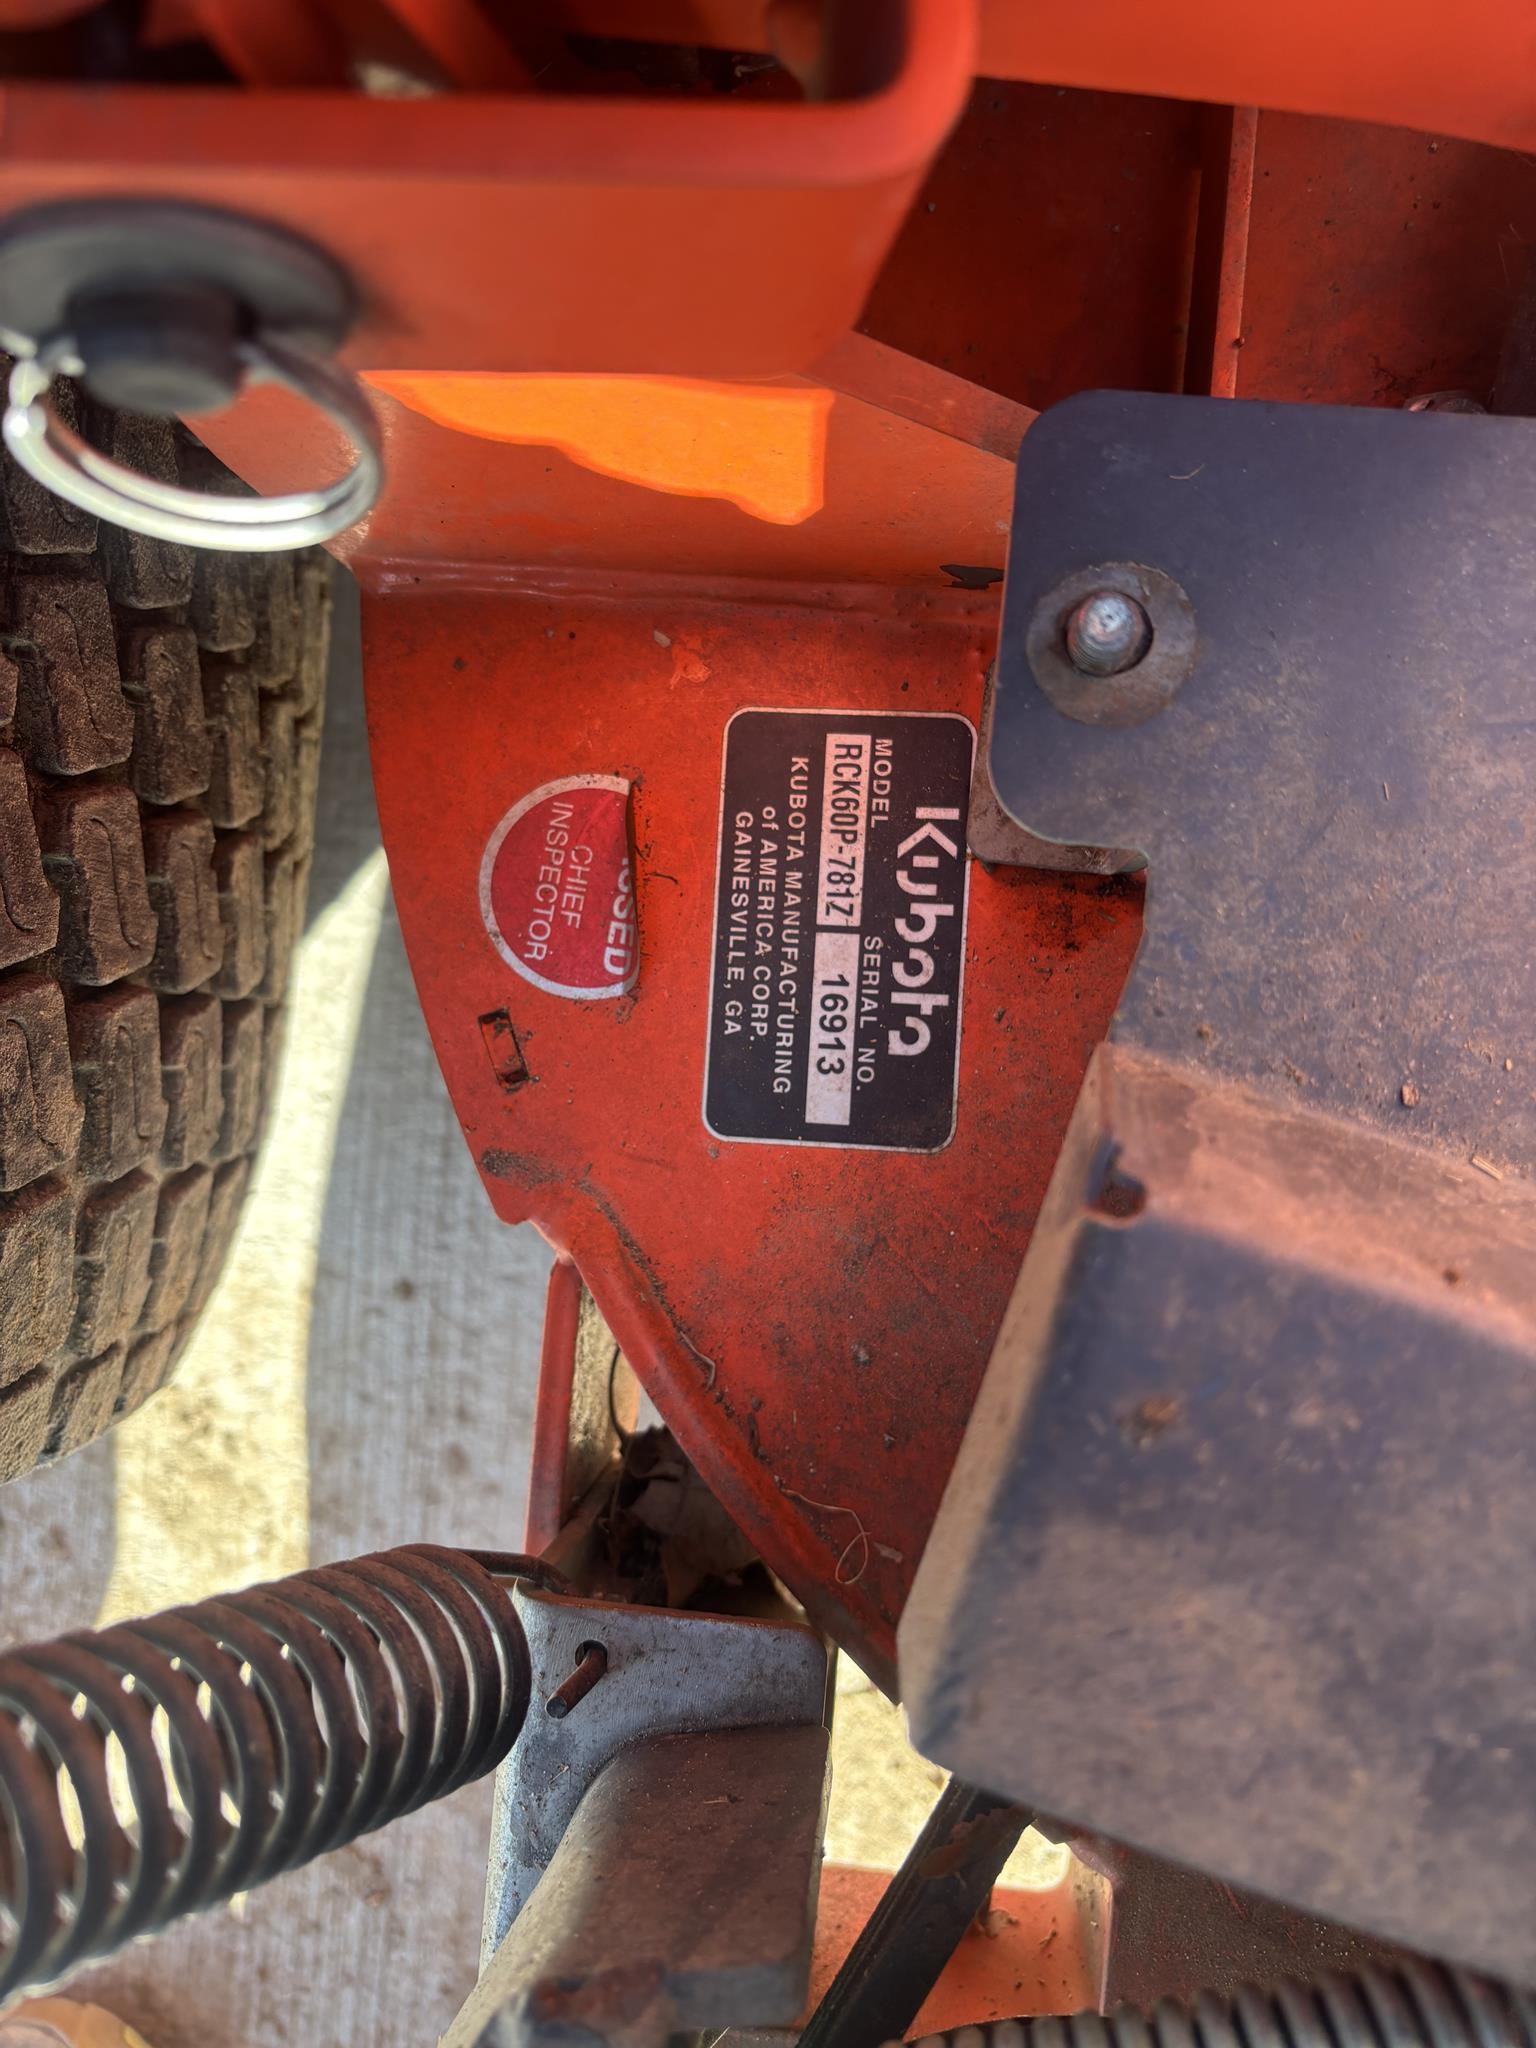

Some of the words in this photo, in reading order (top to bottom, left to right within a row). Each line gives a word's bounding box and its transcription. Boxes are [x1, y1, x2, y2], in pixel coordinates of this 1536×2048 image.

[761, 806, 779, 831] of
[786, 757, 809, 861] KUBOTA
[825, 743, 863, 917] RCK60P-781Z
[870, 738, 893, 828] MODEL
[524, 801, 574, 961] INSPECTOR
[561, 845, 593, 929] CHIEF
[723, 811, 754, 989] GAINESVILLE,
[755, 839, 778, 956] AMERICA
[888, 807, 960, 1056] Kubota
[724, 1000, 743, 1035] GA
[749, 965, 772, 1042] CORP.
[773, 871, 803, 1094] MANUFACTURING
[816, 974, 850, 1076] 16913
[859, 936, 884, 1028] SERIAL
[856, 1047, 876, 1091] NO.
